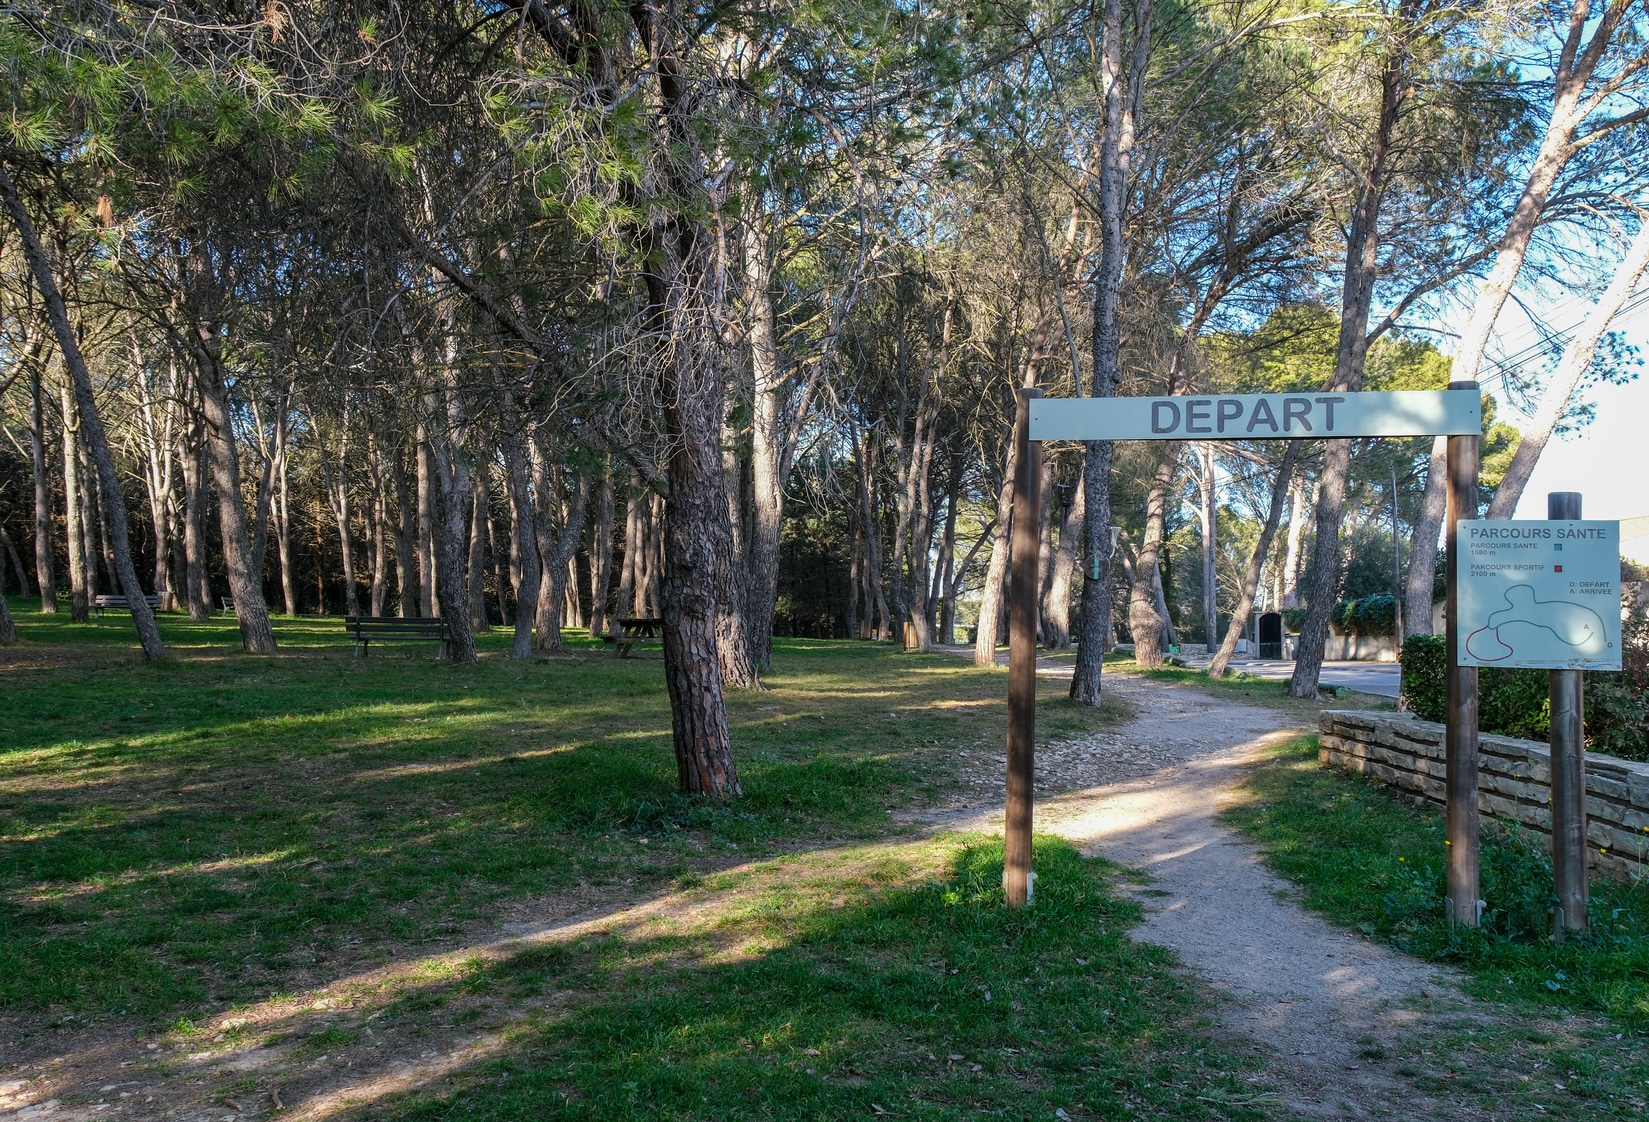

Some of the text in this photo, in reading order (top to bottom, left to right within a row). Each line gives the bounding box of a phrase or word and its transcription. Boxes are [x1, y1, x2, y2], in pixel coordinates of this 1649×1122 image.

[1151, 397, 1345, 433] DEPART
[1470, 528, 1606, 539] PARCOURS SANTE
